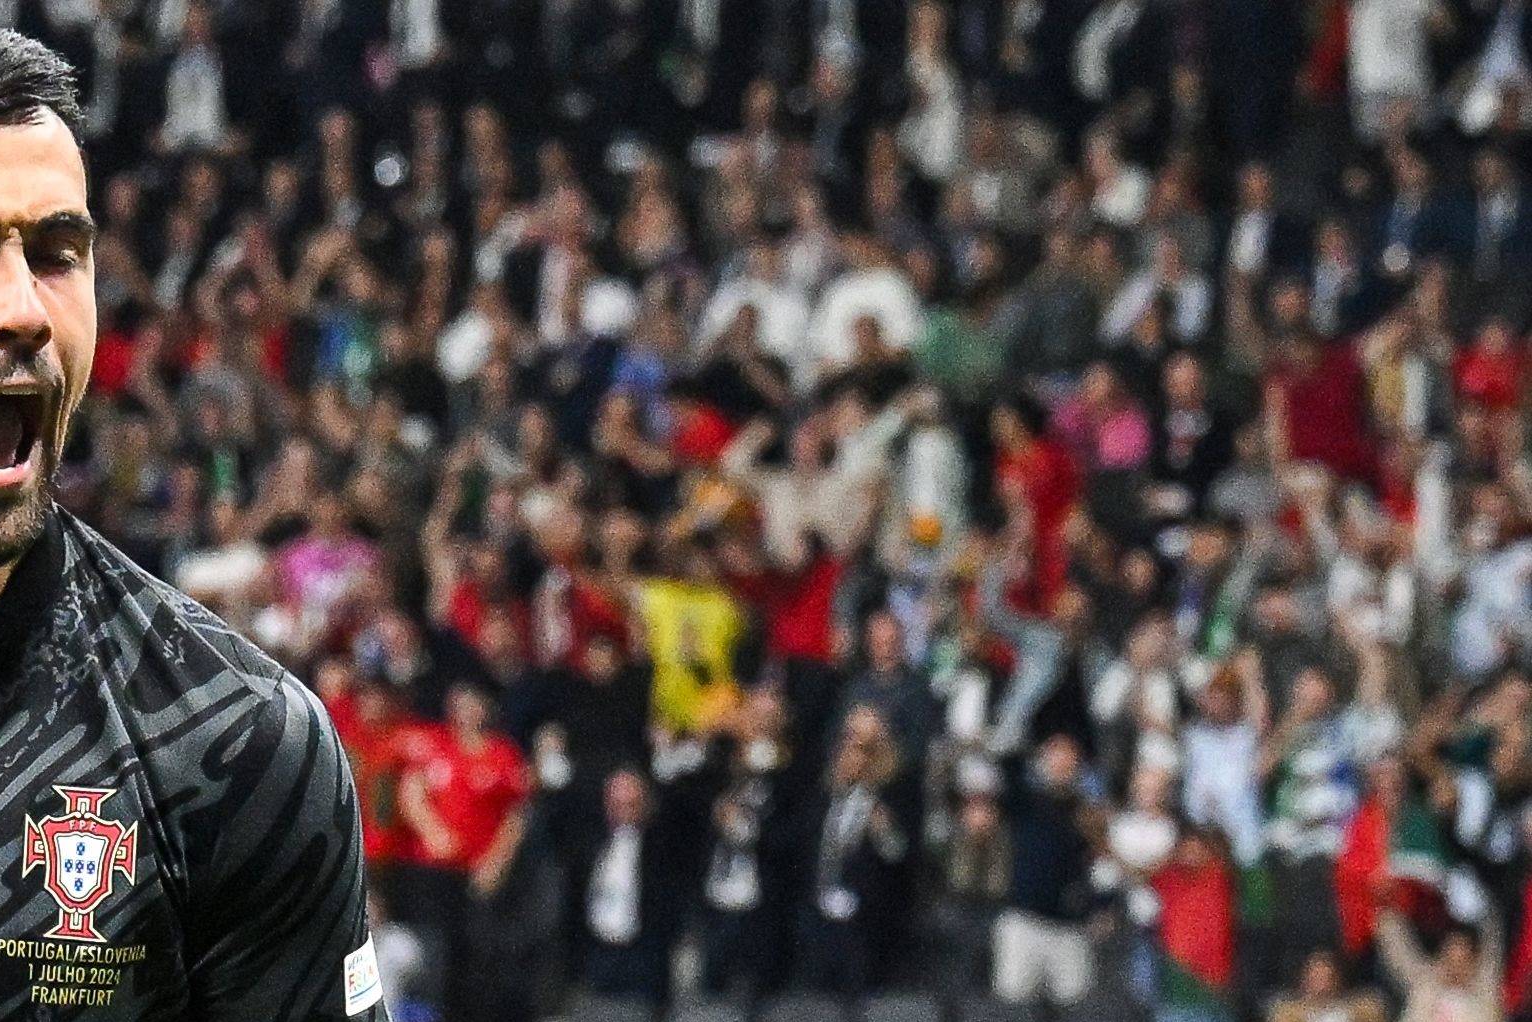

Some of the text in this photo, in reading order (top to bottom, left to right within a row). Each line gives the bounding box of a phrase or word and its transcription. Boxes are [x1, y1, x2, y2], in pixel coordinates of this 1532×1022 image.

[28, 963, 121, 986] 1 JULHO 2024
[30, 985, 115, 1007] FRANKFURT
